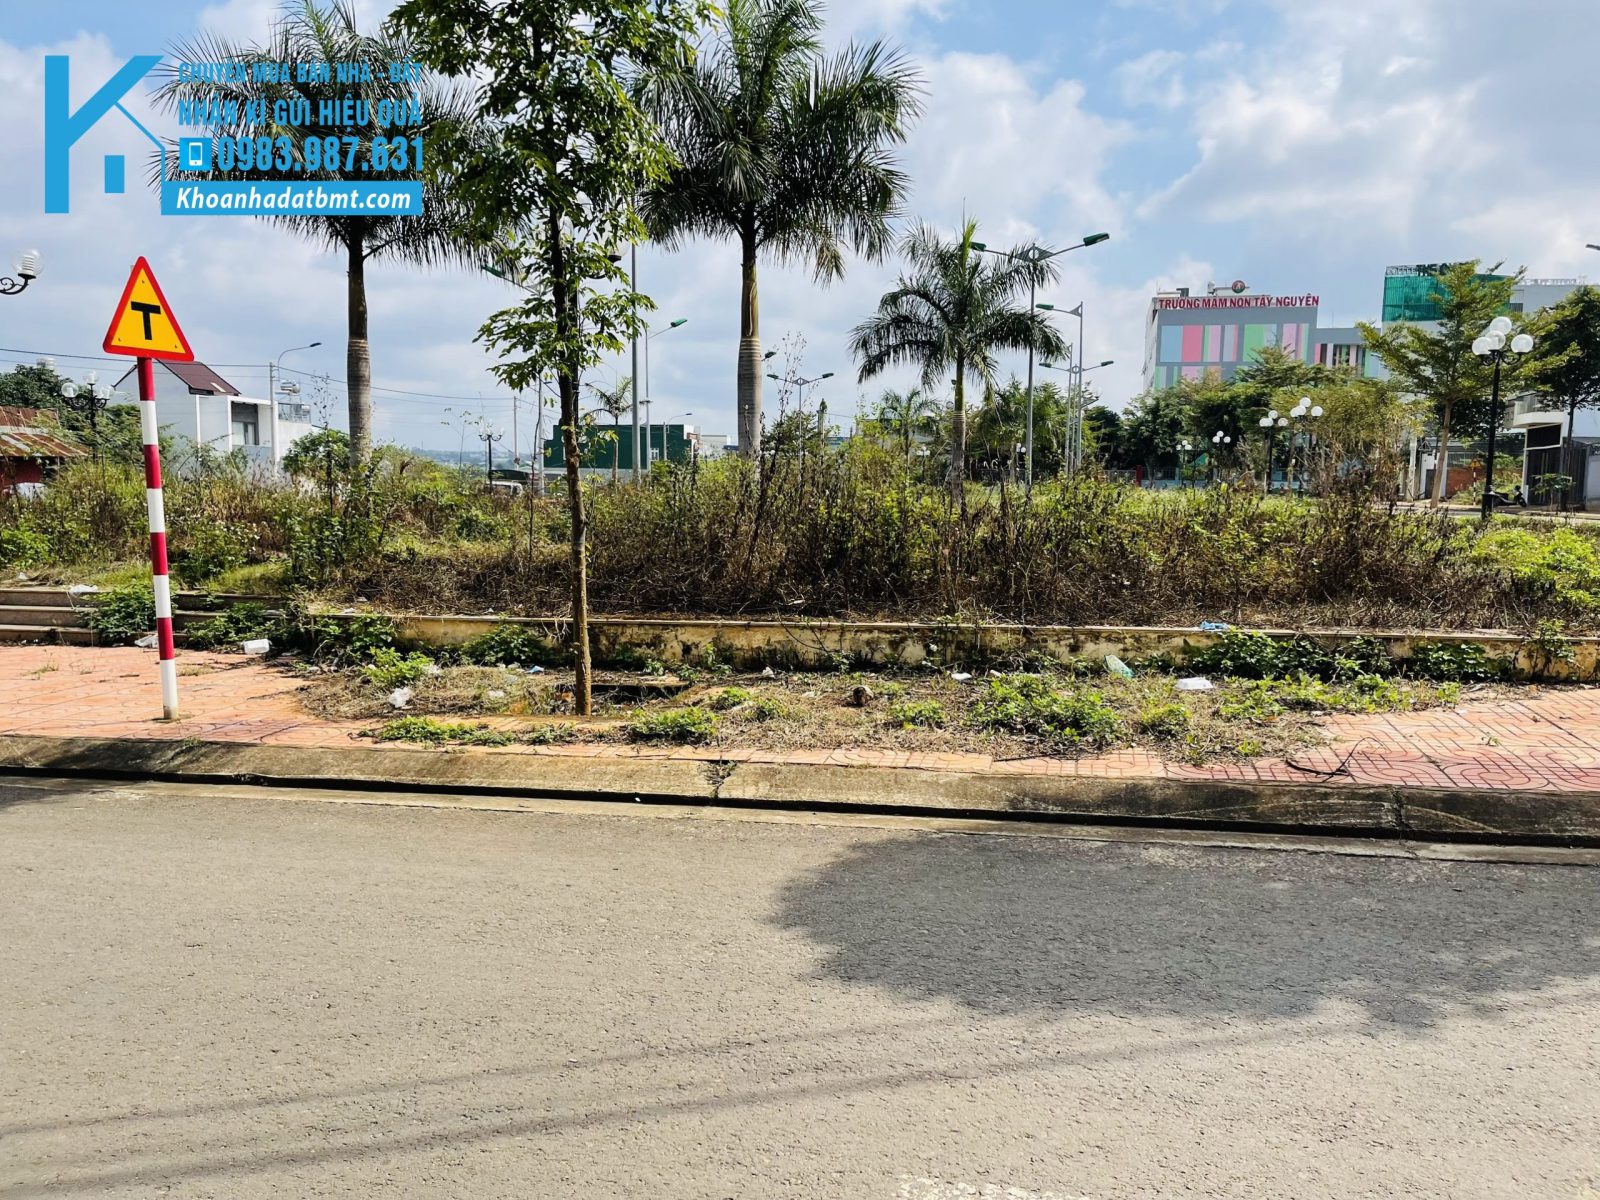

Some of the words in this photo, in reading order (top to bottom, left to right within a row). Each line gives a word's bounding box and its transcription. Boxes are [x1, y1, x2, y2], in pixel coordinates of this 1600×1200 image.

[1230, 297, 1251, 308] NON
[1254, 294, 1273, 306] TÂY
[1275, 293, 1319, 307] NGUYÊN
